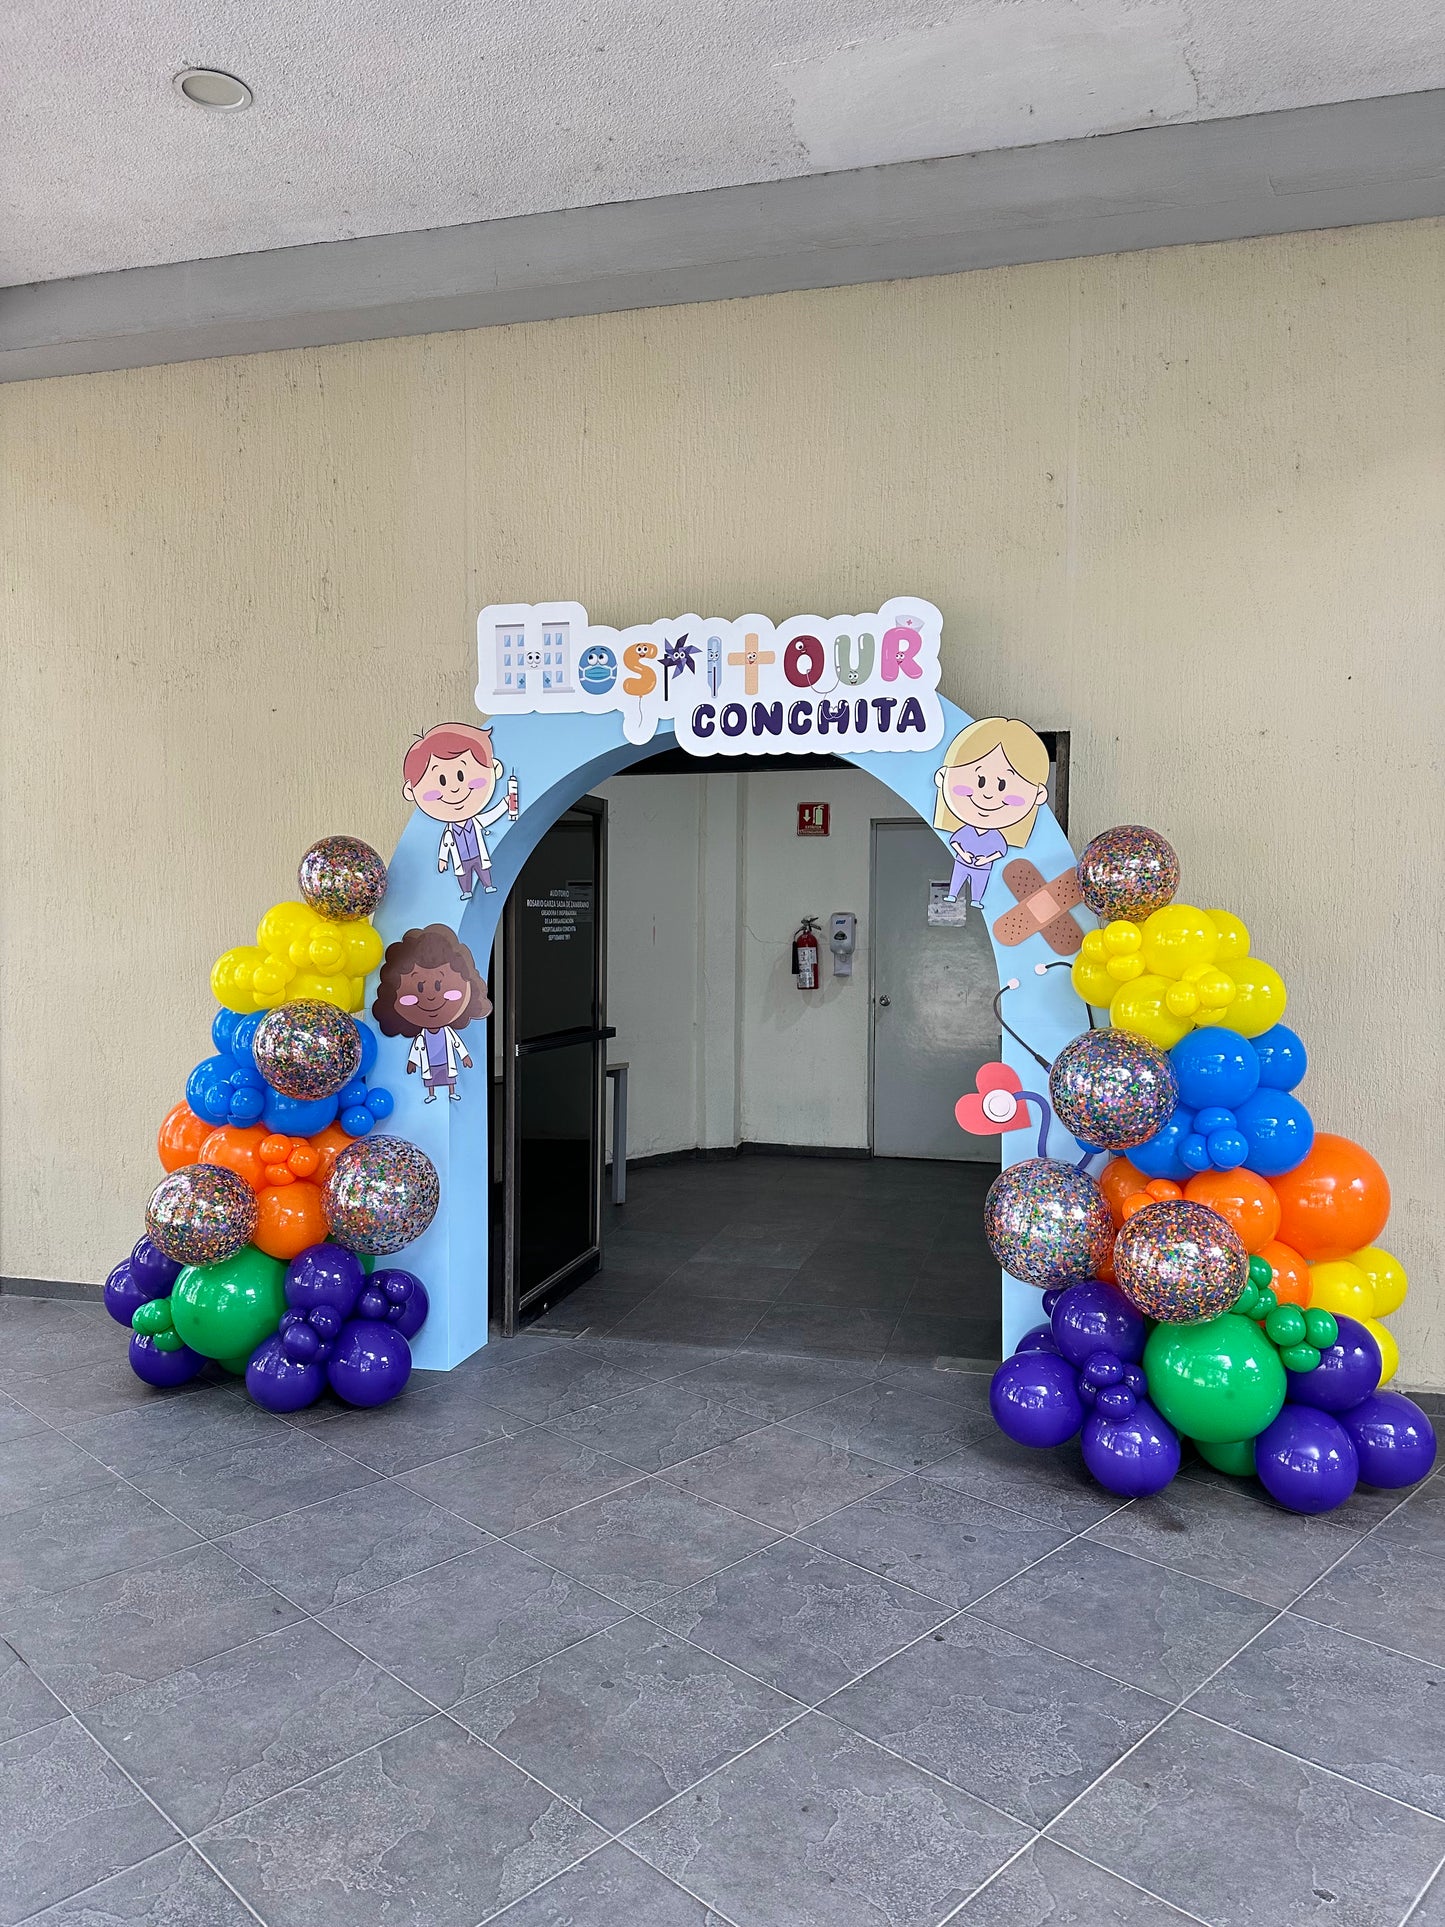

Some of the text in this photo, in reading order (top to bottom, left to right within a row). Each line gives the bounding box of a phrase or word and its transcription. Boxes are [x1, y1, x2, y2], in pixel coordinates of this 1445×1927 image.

[691, 696, 927, 738] CONCHITA
[549, 889, 570, 897] AUDITORIO
[526, 899, 590, 908] ROSARIO GARZA SADA DE ZAMBRANO
